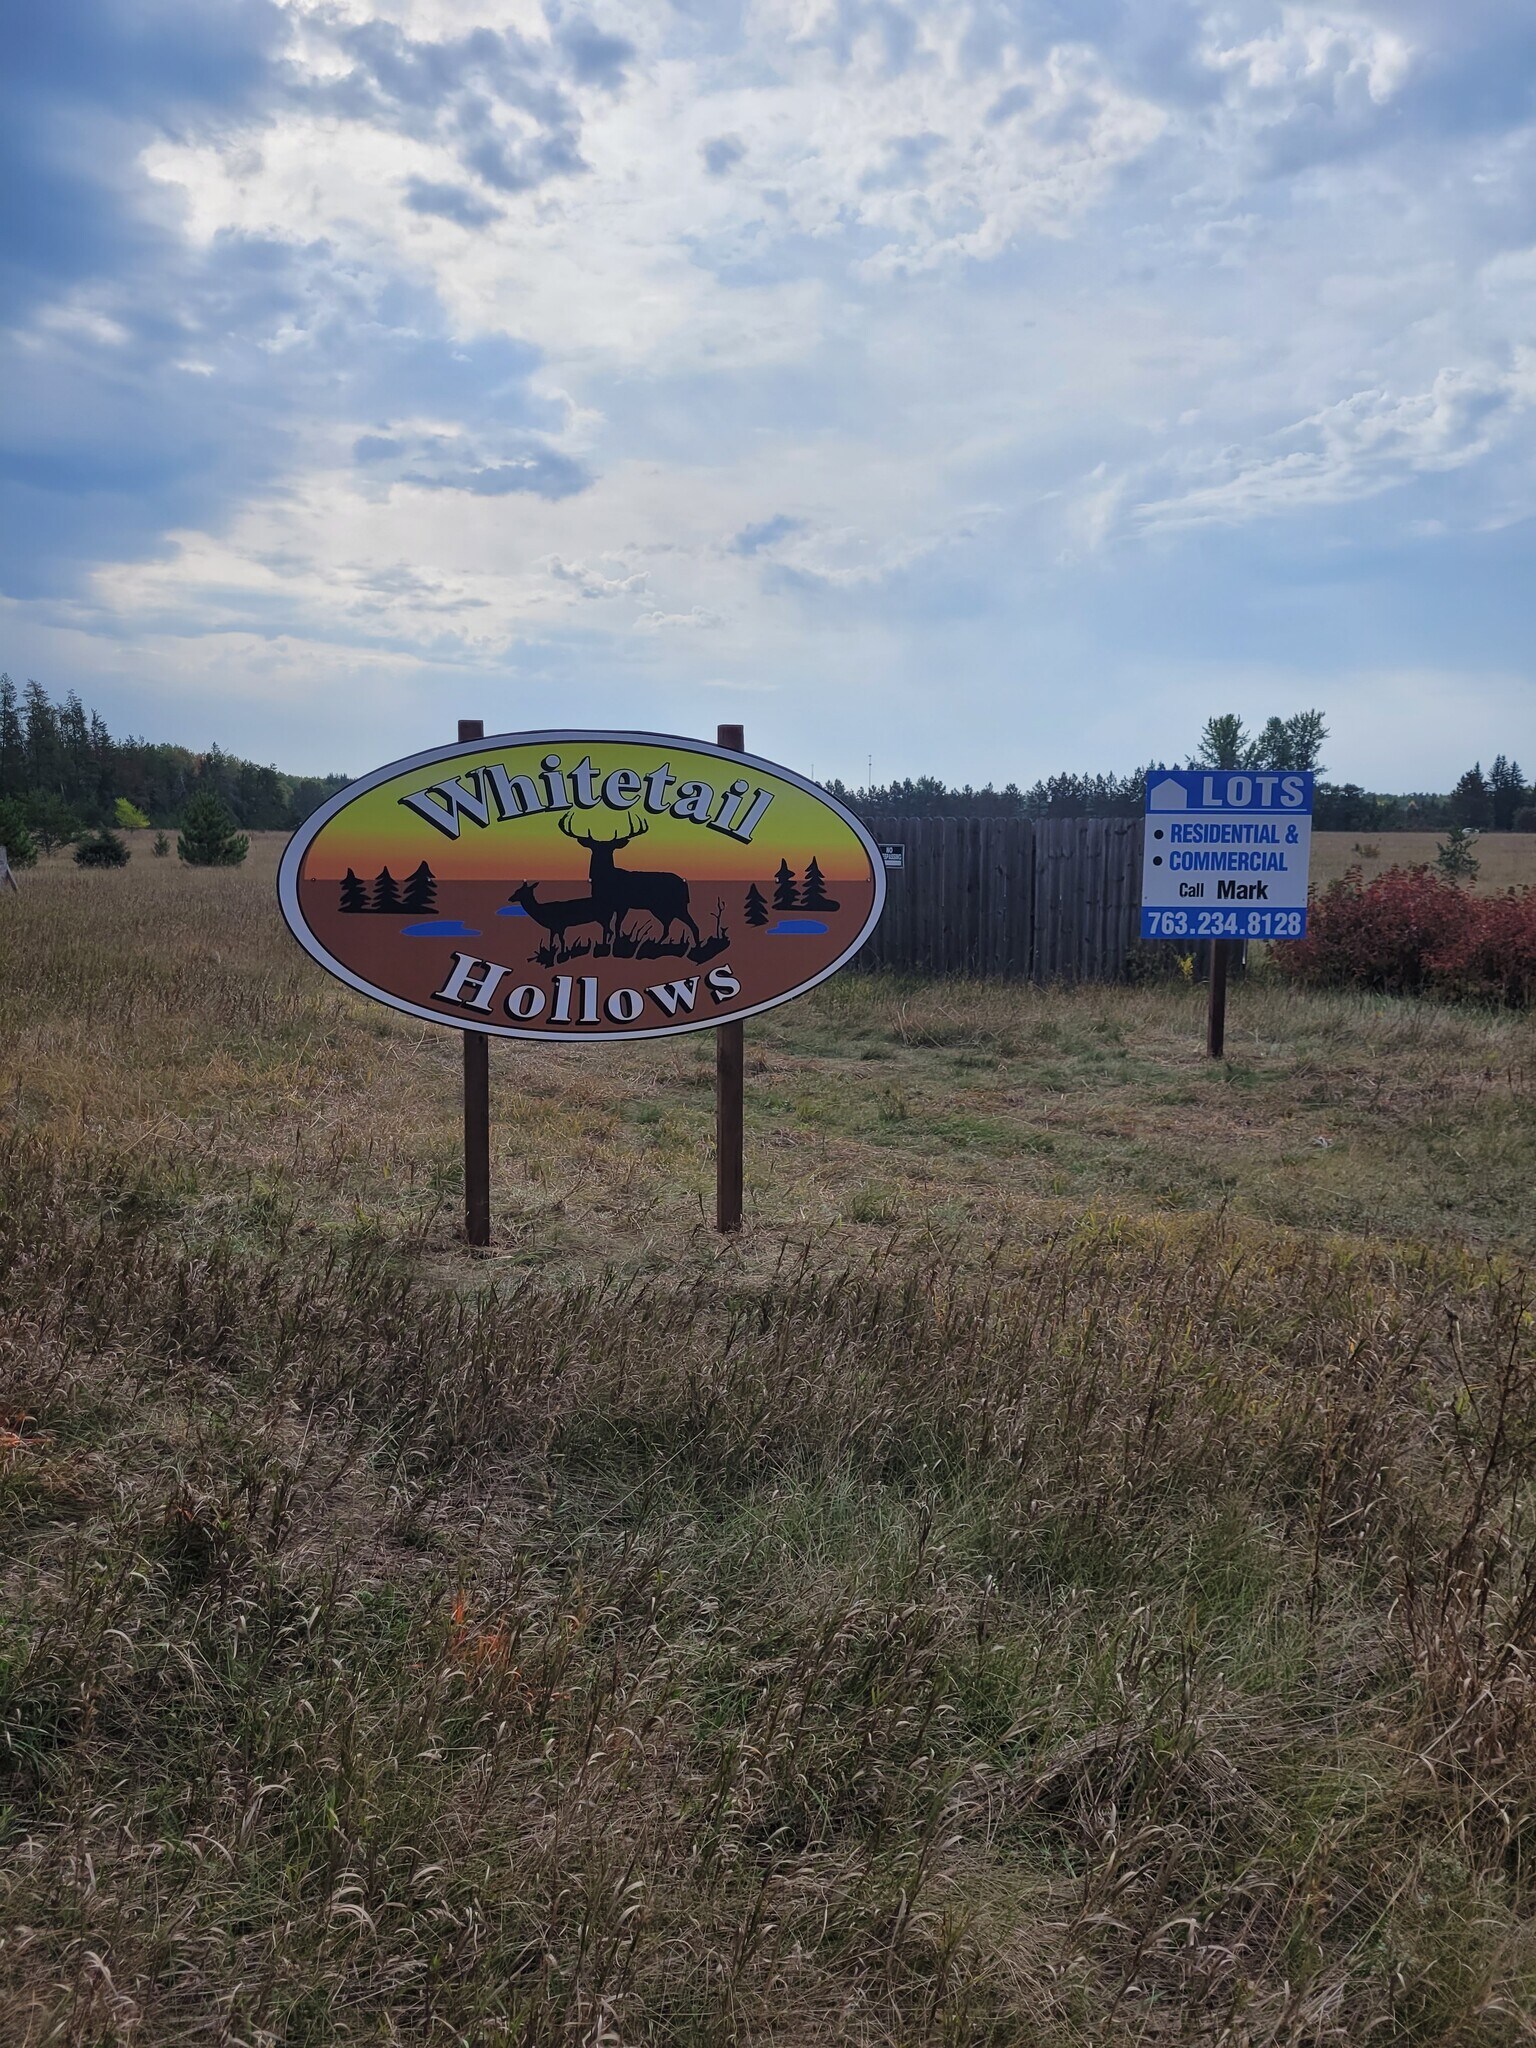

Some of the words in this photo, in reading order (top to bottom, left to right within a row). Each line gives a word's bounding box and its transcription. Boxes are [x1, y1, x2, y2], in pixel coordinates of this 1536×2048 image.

[397, 753, 775, 845] Whitetail
[1202, 775, 1305, 808] LOTS
[1170, 823, 1280, 844] RESIDENTIAL
[1285, 823, 1299, 844] &
[1169, 850, 1288, 872] COMMERCIAL
[1179, 882, 1204, 898] Call
[1217, 880, 1269, 900] Mark
[1148, 911, 1302, 935] 763.234.8128
[431, 951, 742, 1025] Hollows
